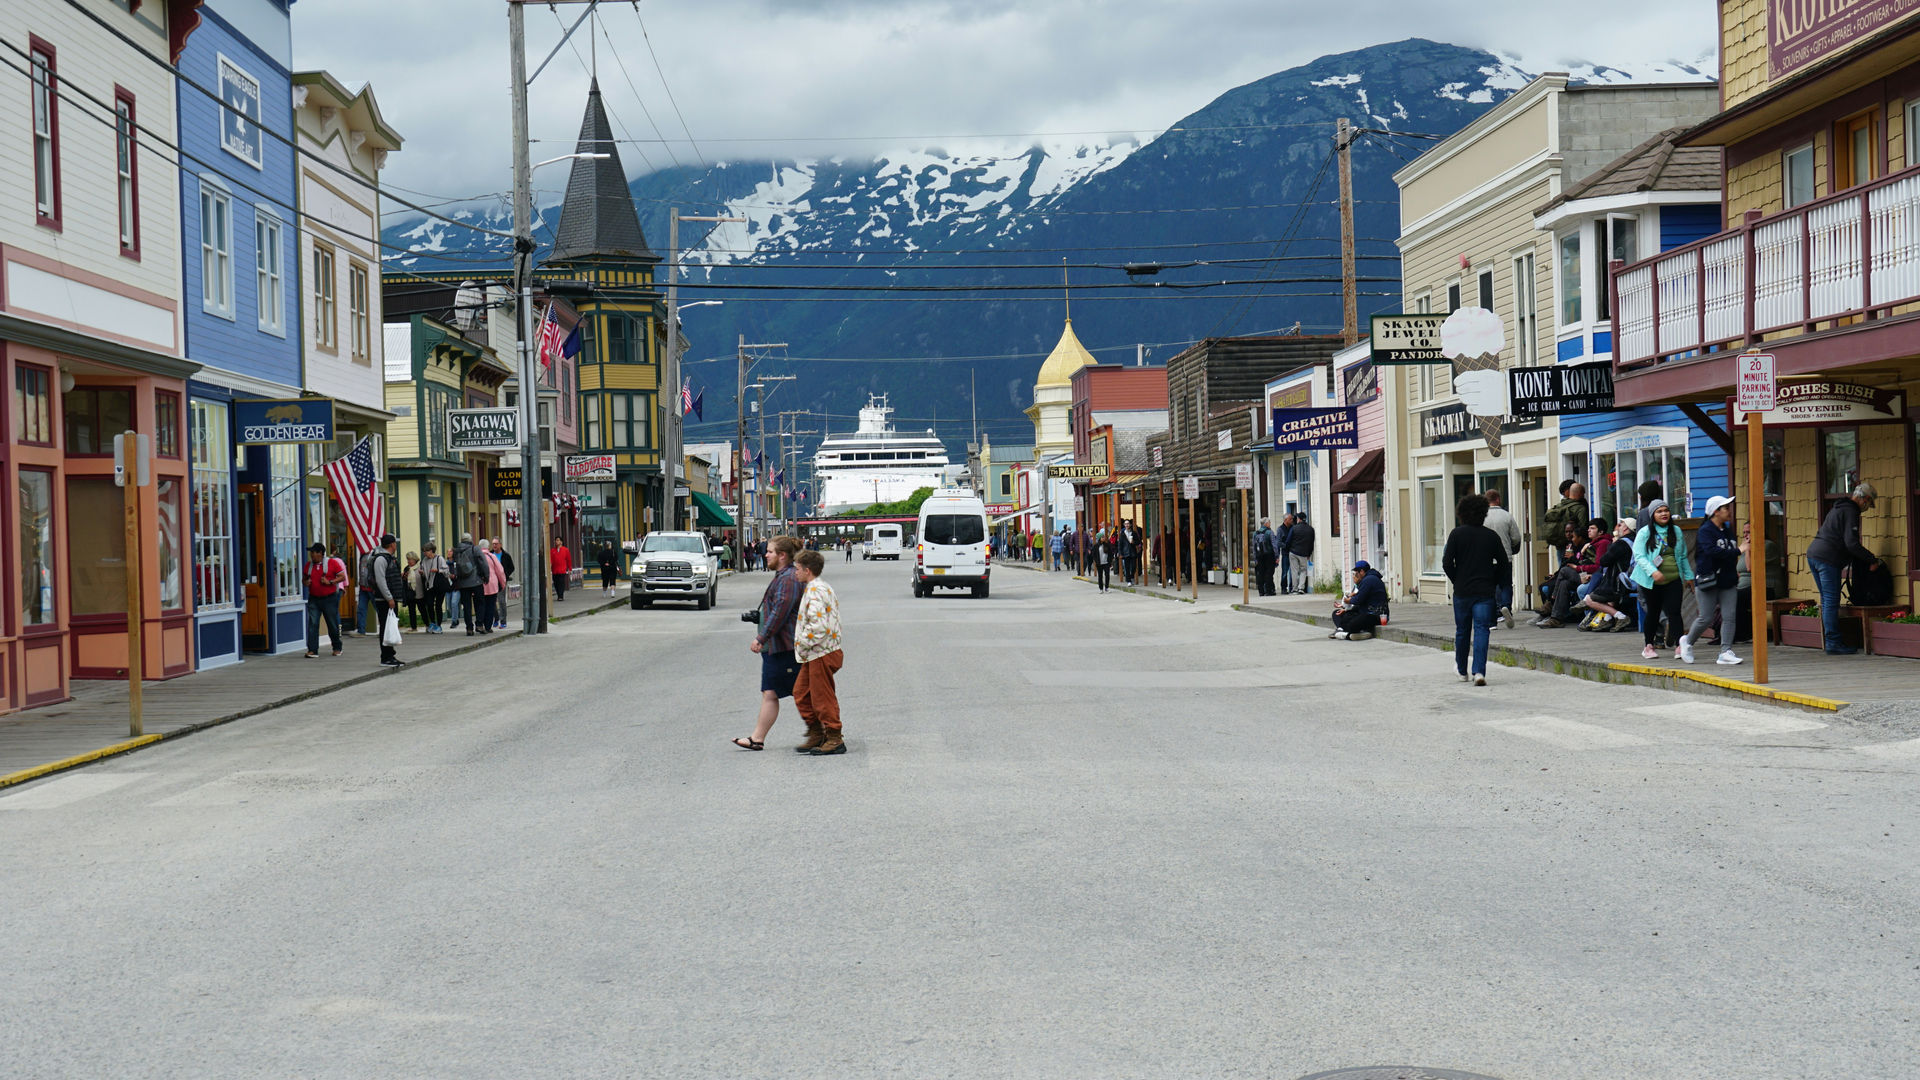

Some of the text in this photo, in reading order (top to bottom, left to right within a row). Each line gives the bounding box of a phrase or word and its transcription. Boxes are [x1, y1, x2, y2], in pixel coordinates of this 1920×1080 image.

[1782, 46, 1810, 70] SOUVENIRS
[1813, 36, 1828, 54] GIFTS
[1831, 24, 1854, 46] APPAREL
[1857, 4, 1890, 32] FOOTWEAR
[230, 133, 254, 158] NATIVE ART
[1383, 320, 1445, 329] SKAGW
[1383, 330, 1441, 339] JEWEL
[1410, 339, 1432, 347] CO.
[1750, 361, 1762, 371] 20
[1743, 373, 1768, 382] MINUTE
[1514, 371, 1553, 399] KONE
[1741, 384, 1771, 393] PARKING
[1776, 383, 1876, 400] OTHES RUSH
[1528, 402, 1539, 412] ICE
[1541, 401, 1561, 411] CREAM
[1569, 399, 1588, 409] CANDY
[1783, 404, 1852, 414] SOUVENIRS
[452, 415, 515, 433] SKAGWAY
[1282, 411, 1347, 432] CREATIVE
[1424, 411, 1465, 438] SKAGWAY
[244, 426, 325, 441] GOLDEN BEAR
[467, 431, 502, 439] TOURS
[1277, 421, 1354, 444] GOLDSMITH
[1310, 438, 1353, 446] OF ALASKA
[567, 457, 613, 476] HARDWARE
[1059, 466, 1107, 477] PANTHEON
